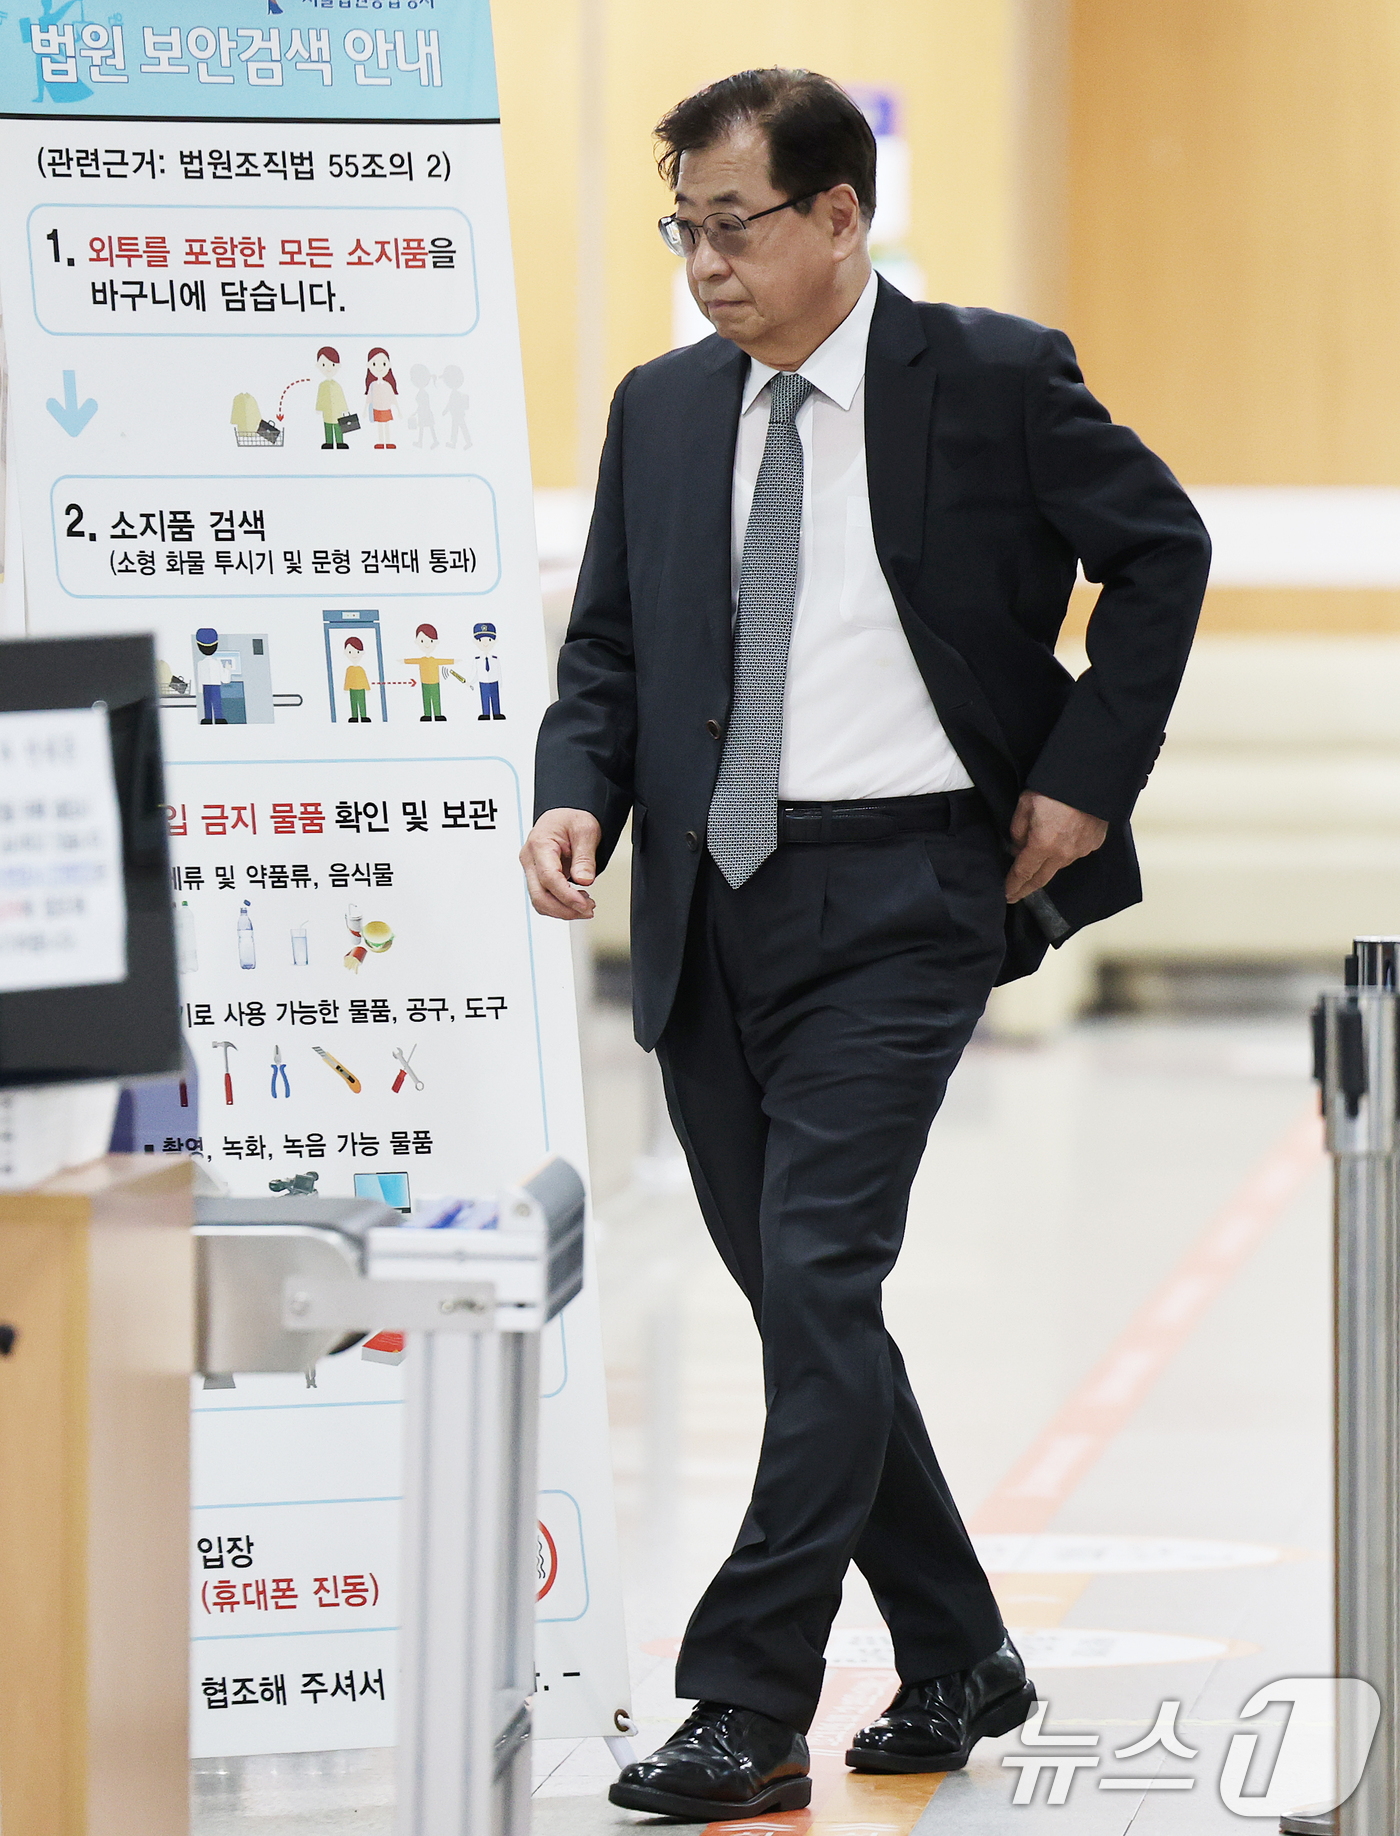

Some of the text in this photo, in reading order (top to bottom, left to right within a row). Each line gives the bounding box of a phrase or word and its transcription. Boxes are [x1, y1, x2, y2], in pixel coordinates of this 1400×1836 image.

[30, 23, 443, 88] 법원 보안검색 안내
[38, 147, 450, 182] (관련근거: 법원조직법 55조의 2)
[47, 229, 456, 269] 1. 외투를 포함한 모든 소지품을
[91, 279, 345, 312] 바구니에 담습니다.
[65, 503, 265, 542] 2. 소지품 검색
[110, 548, 476, 576] (소형 화물 투시기 및 문형 검색대 통과)
[201, 803, 257, 835] 금지
[270, 803, 325, 834] 물품
[335, 801, 389, 833] 확인
[402, 800, 429, 832] 및
[442, 799, 498, 830] 보관
[215, 865, 236, 890] 및
[246, 865, 318, 889] 약품류,
[329, 863, 394, 887] 음식물
[224, 1001, 266, 1026] 사용
[276, 1000, 339, 1025] 가능한
[348, 999, 397, 1024] 물품,
[406, 998, 455, 1022] 공구,
[465, 996, 508, 1020] 도구
[222, 1135, 272, 1160] 녹화,
[283, 1133, 326, 1158] 녹음
[337, 1132, 380, 1157] 가능
[390, 1130, 433, 1155] 물품
[197, 1535, 254, 1569] 입장
[202, 1573, 379, 1614] (휴대폰 진동)
[201, 1674, 287, 1709] 협조해
[301, 1668, 385, 1704] 주셔서
